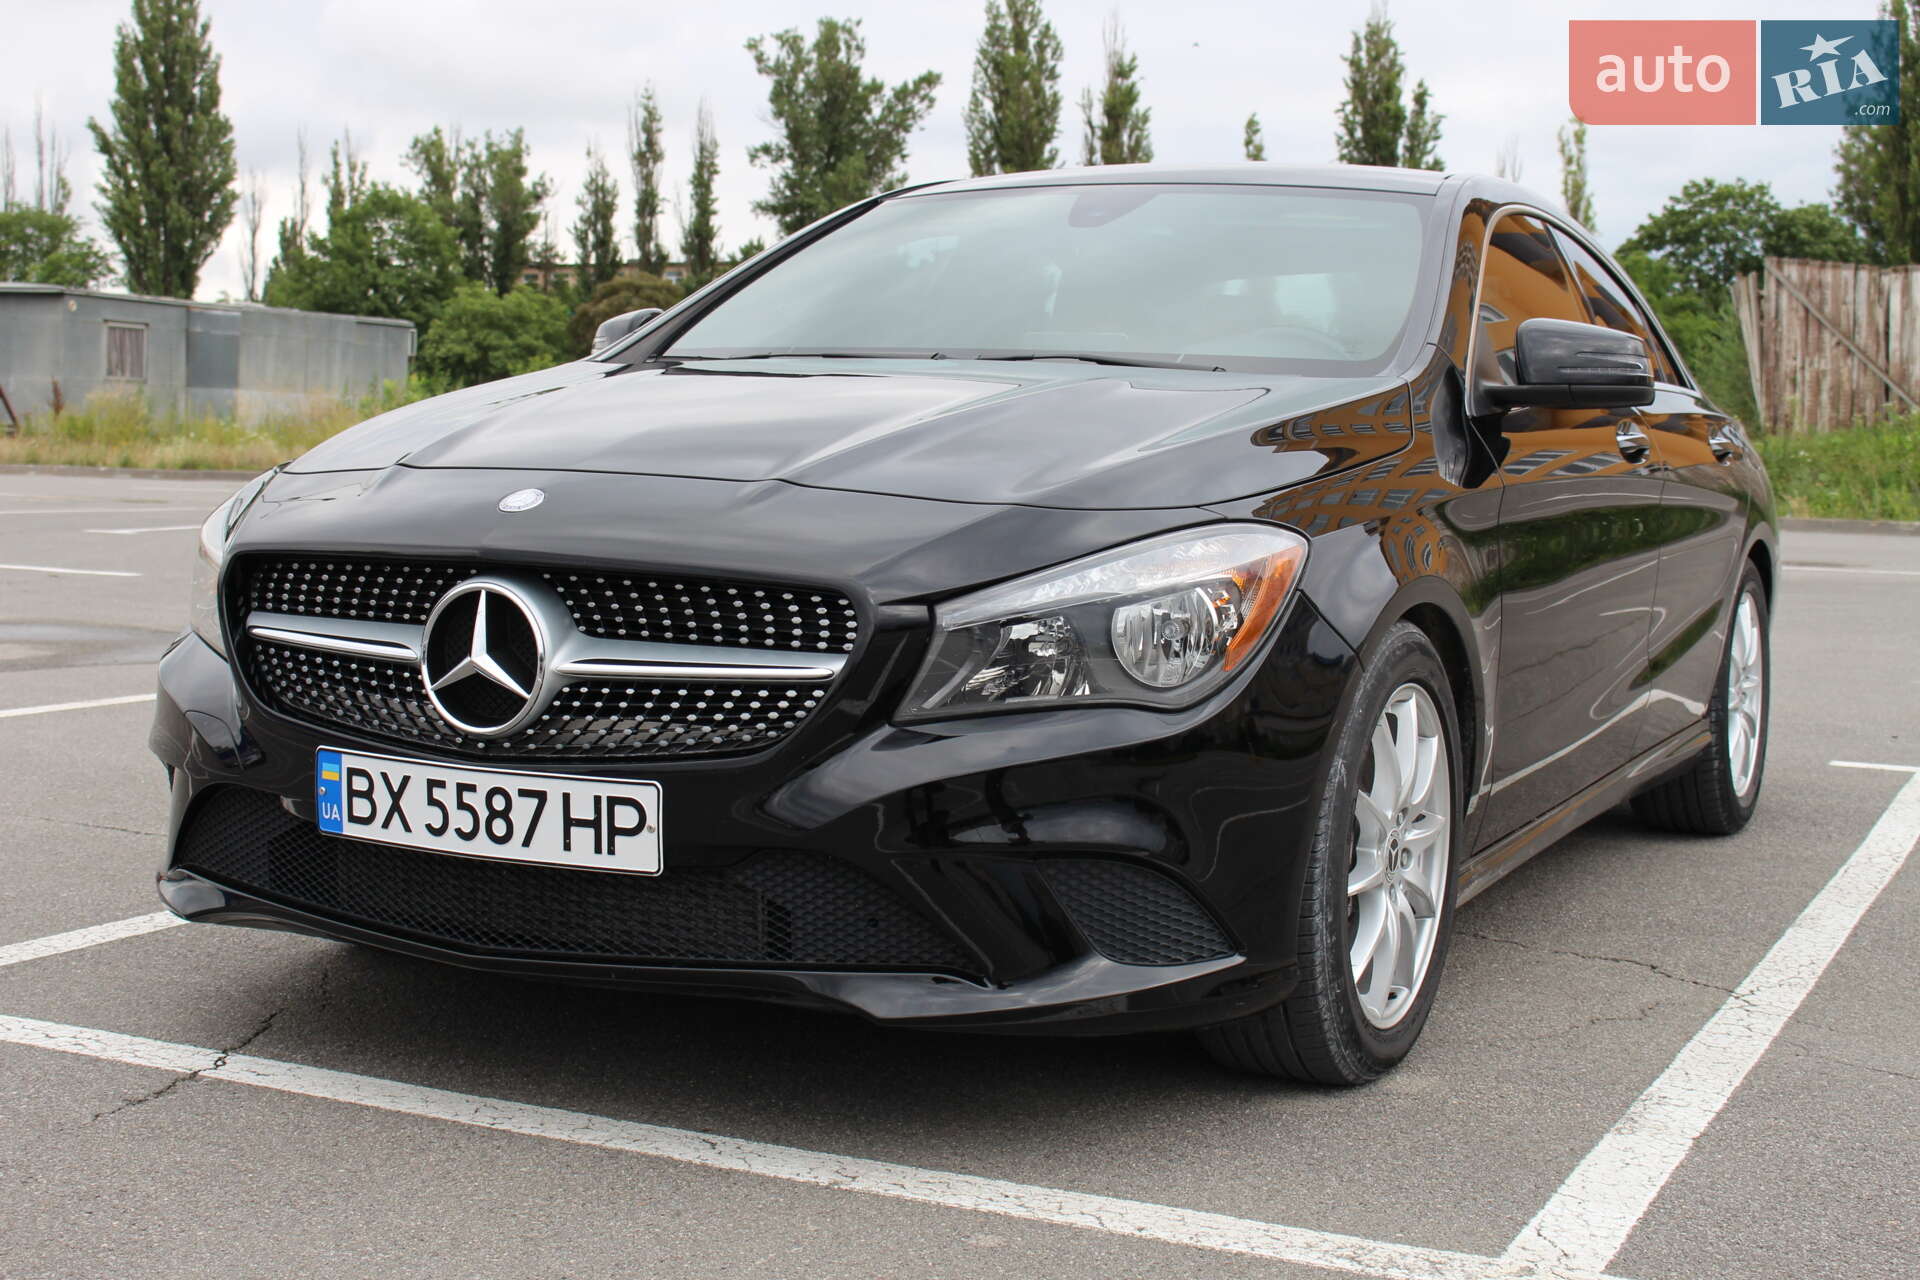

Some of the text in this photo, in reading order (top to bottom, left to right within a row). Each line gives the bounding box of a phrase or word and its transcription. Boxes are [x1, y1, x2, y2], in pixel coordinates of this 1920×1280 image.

[322, 802, 340, 821] UA
[347, 766, 647, 856] BX 5587 HP
